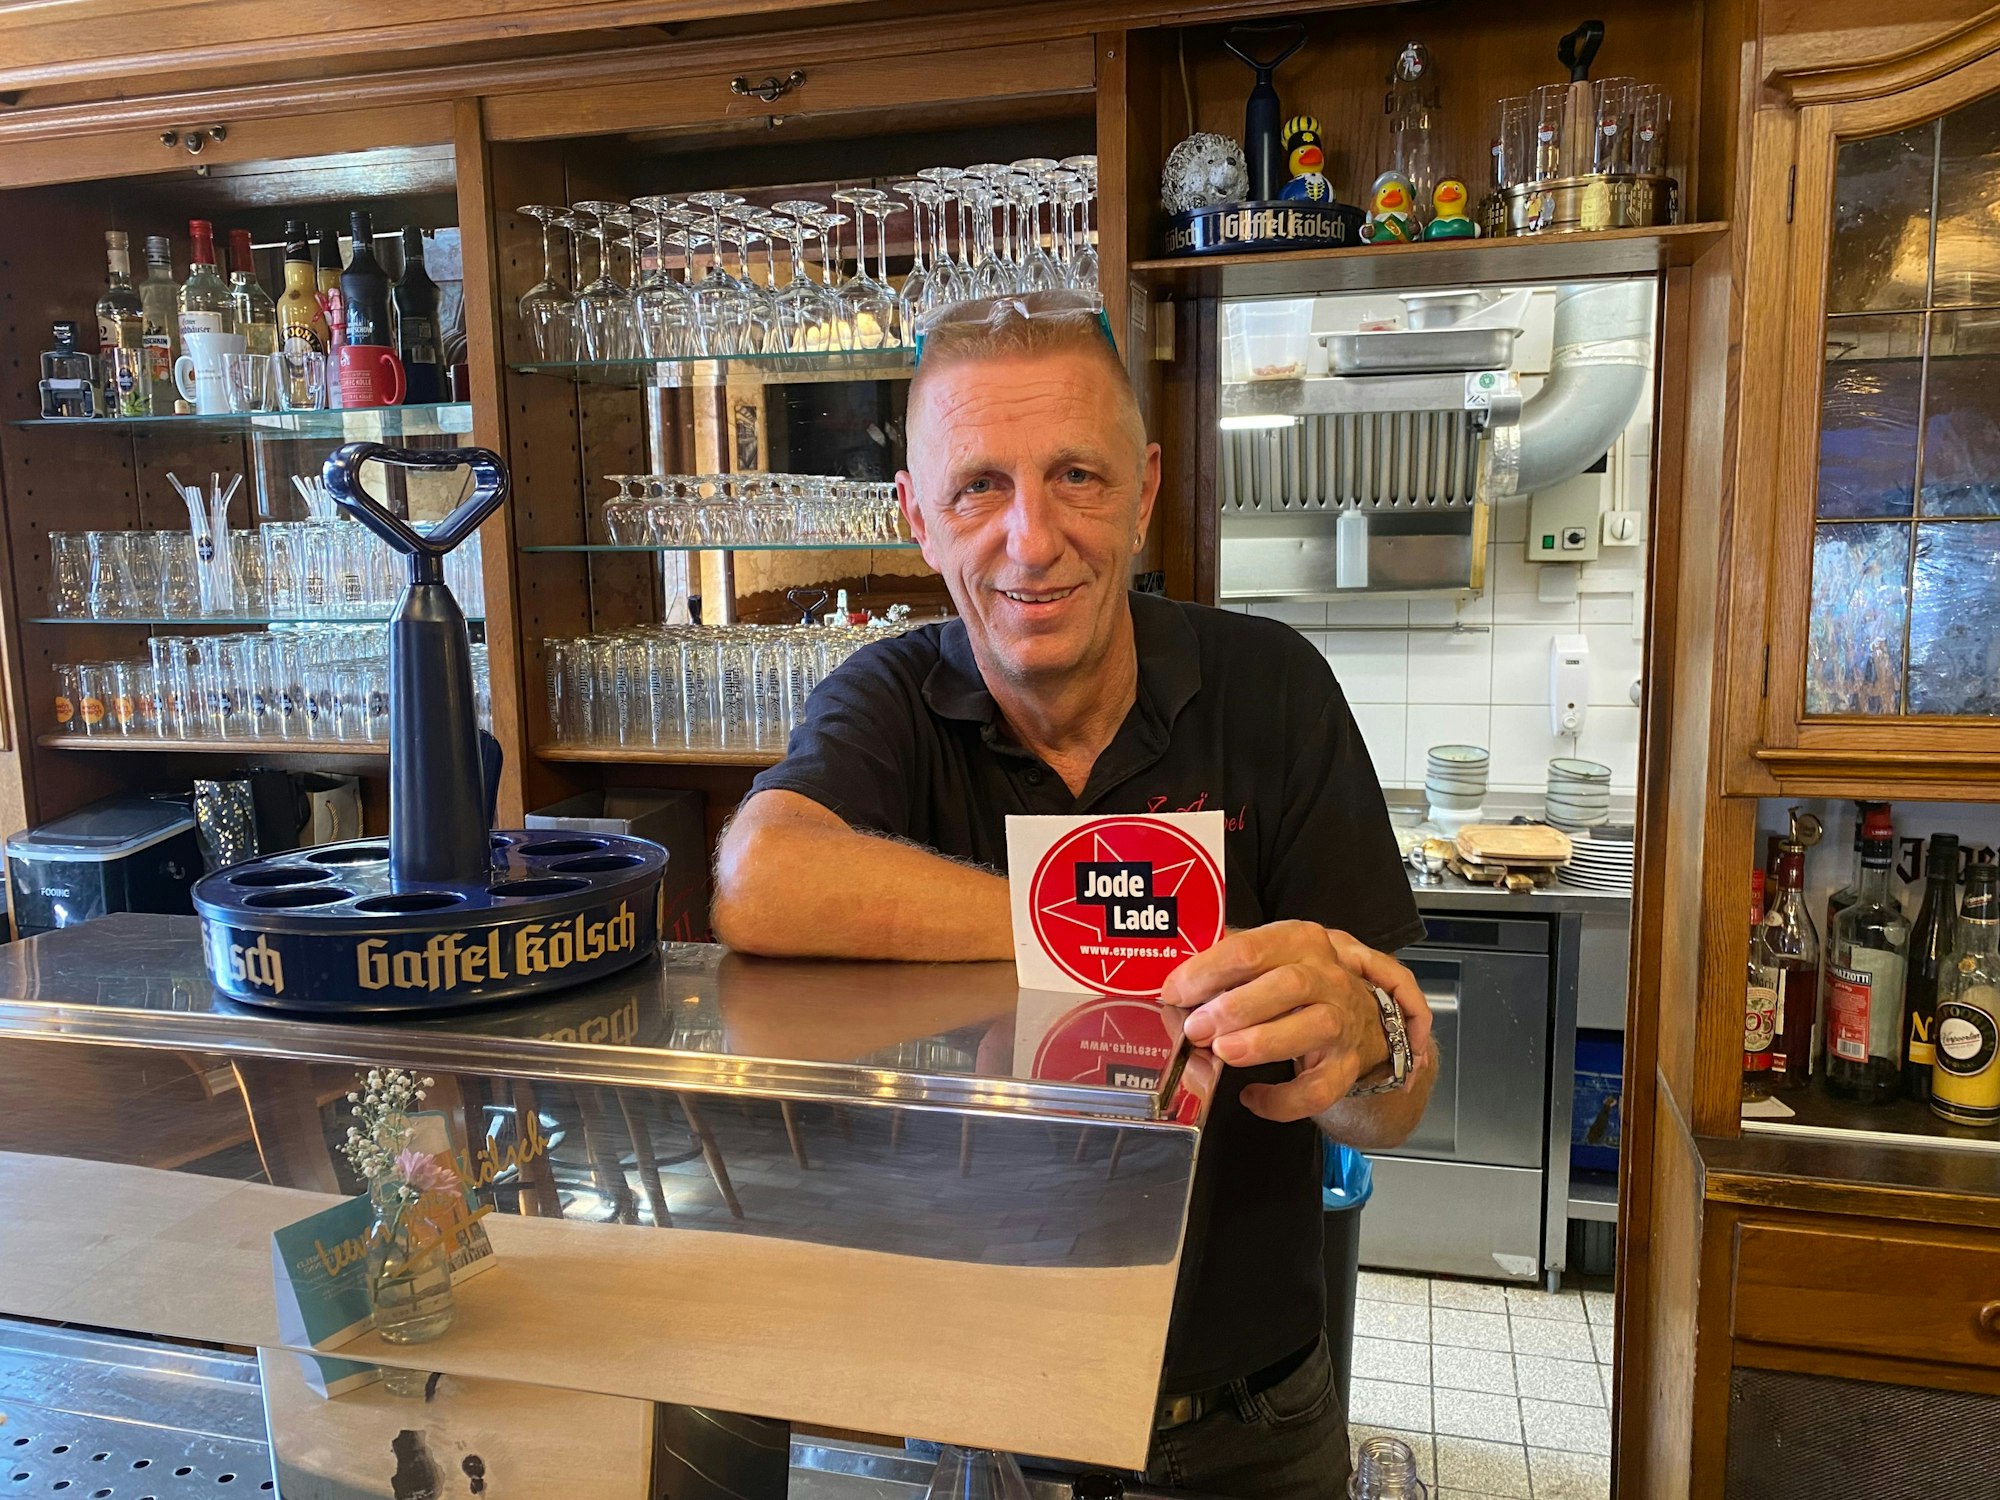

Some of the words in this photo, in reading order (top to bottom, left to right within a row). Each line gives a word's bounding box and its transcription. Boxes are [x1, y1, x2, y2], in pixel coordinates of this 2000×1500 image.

[1225, 210, 1287, 241] Gaffel
[1291, 211, 1346, 242] Kölsch
[1083, 869, 1145, 898] Jode
[1113, 904, 1170, 931] Lade
[356, 928, 508, 993] Gaffel
[514, 899, 636, 977] Kölsch
[1079, 944, 1178, 959] www.express.de
